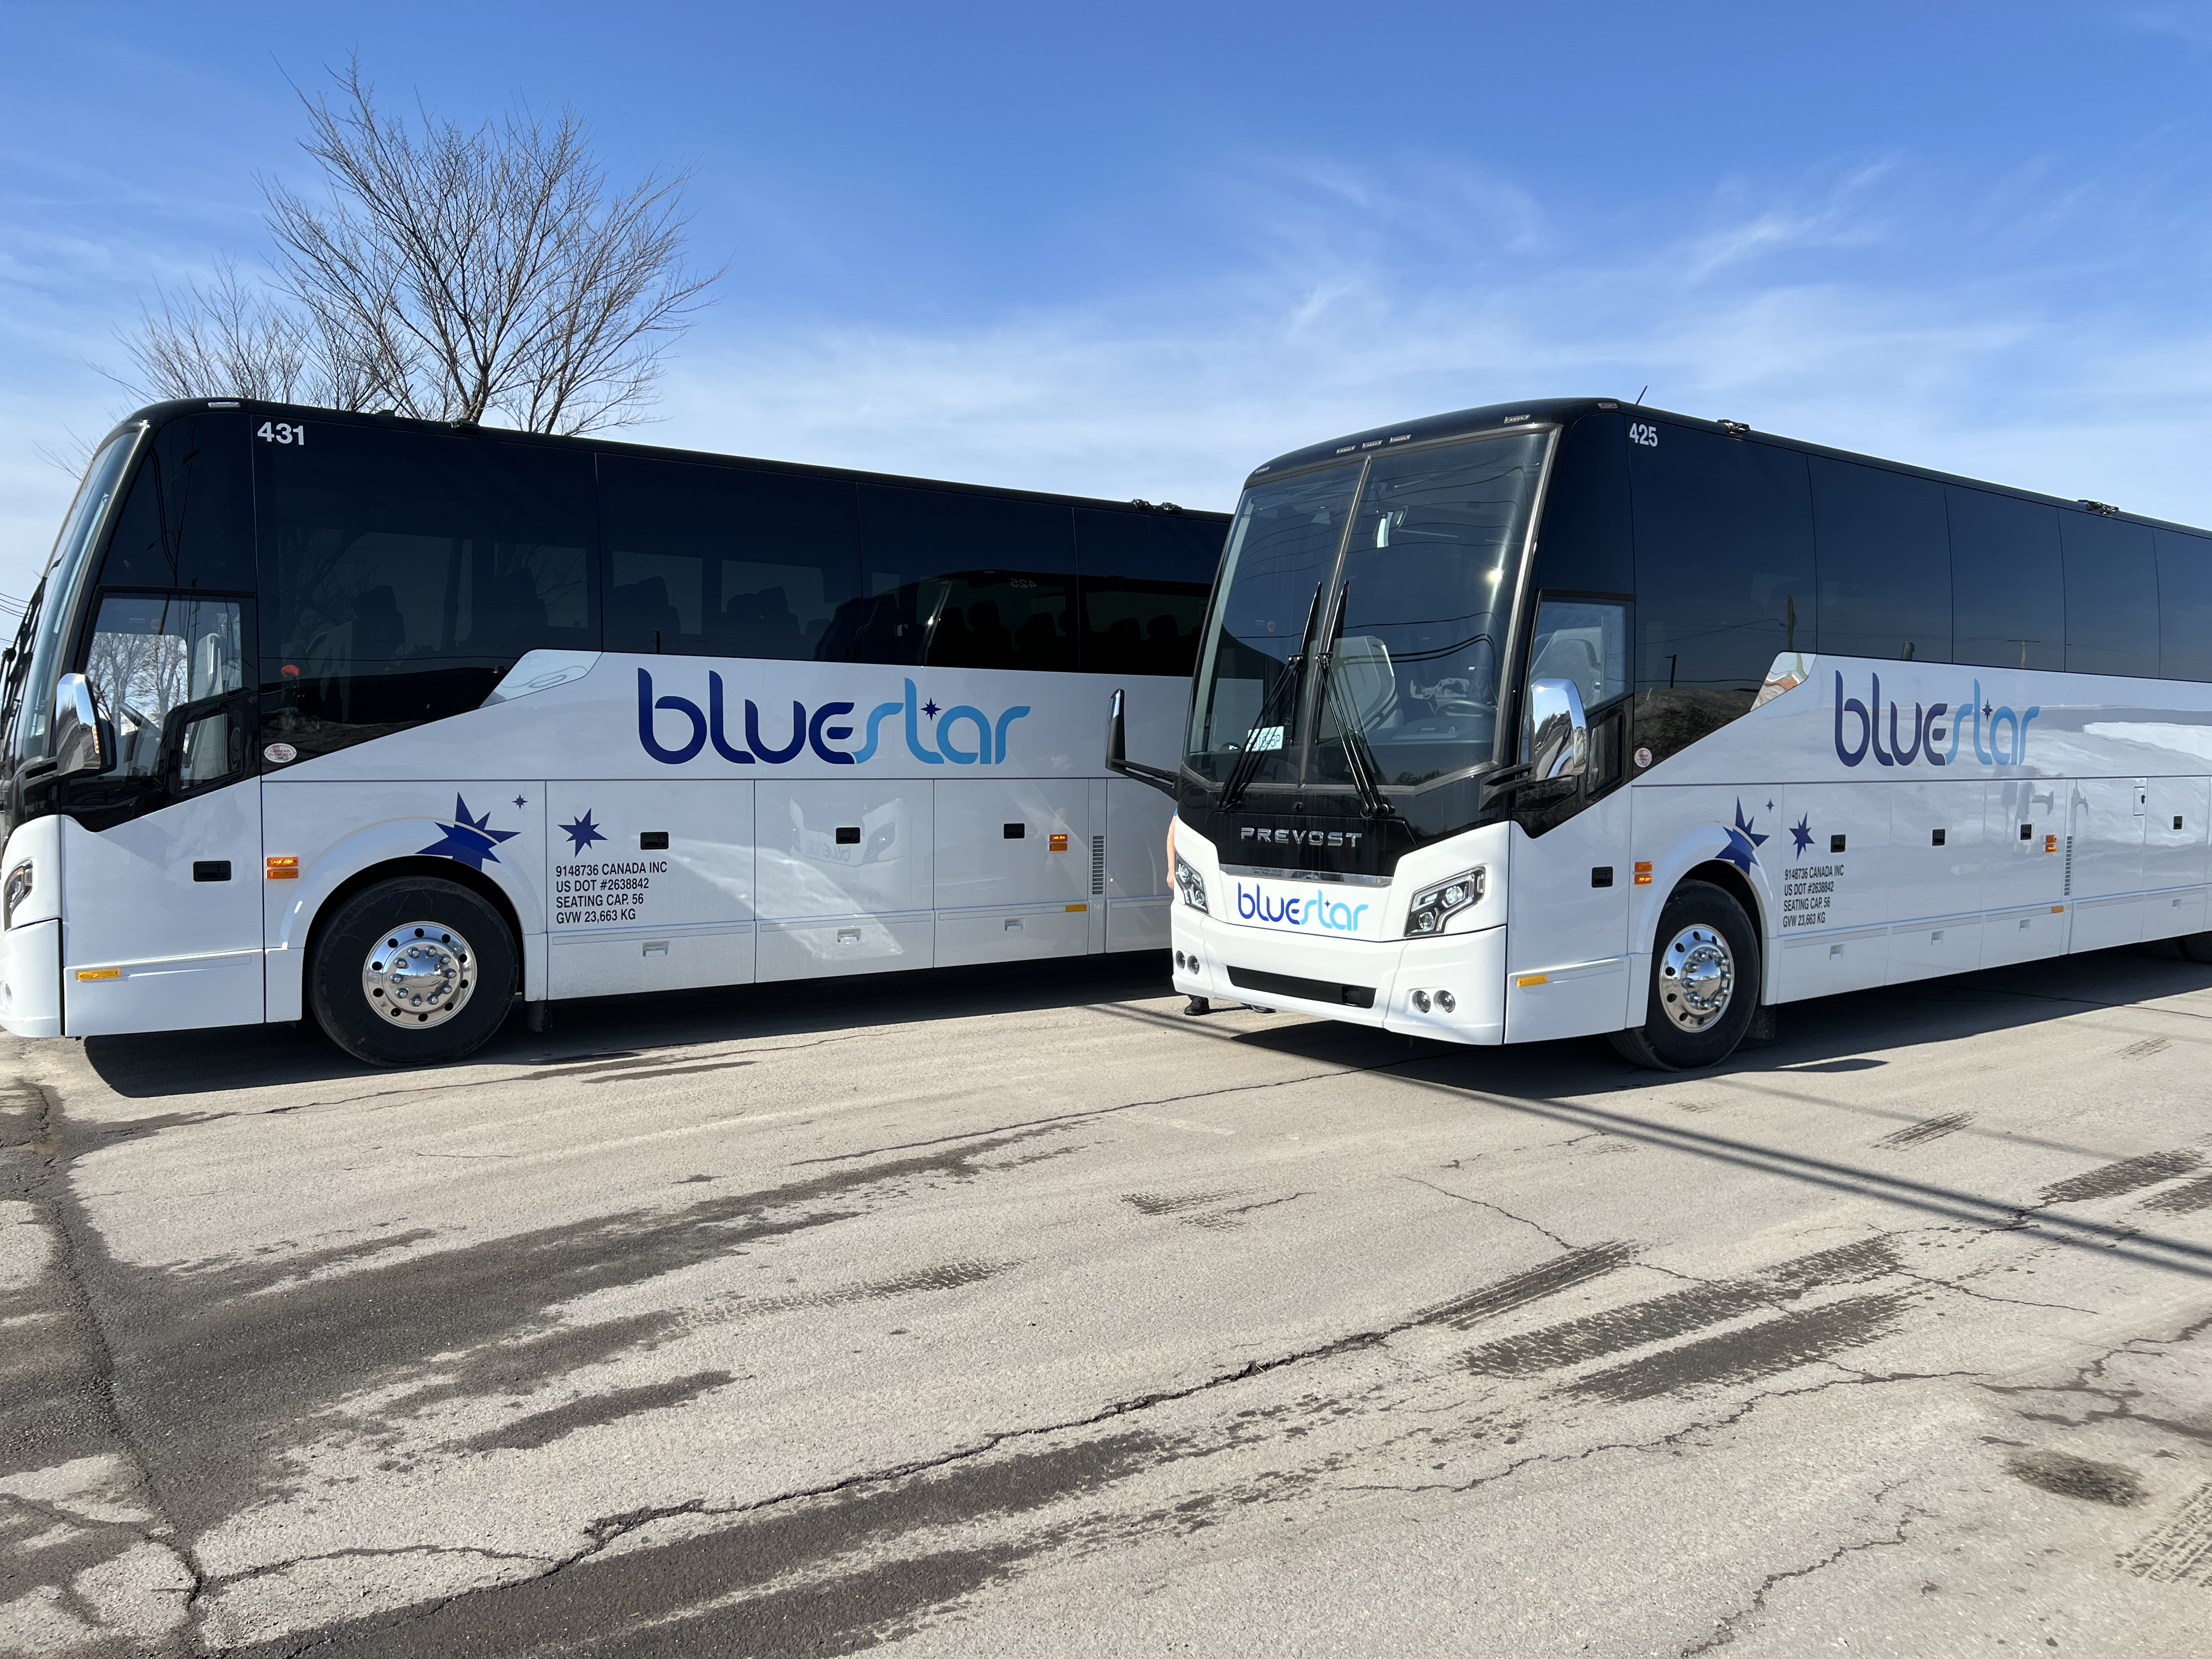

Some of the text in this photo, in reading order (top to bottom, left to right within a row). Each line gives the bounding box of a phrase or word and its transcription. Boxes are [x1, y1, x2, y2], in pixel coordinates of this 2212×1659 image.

[257, 421, 304, 445] 431
[1629, 423, 1658, 447] 425
[637, 667, 1031, 765] bluestar
[1835, 670, 2040, 768] bluestar
[1240, 826, 1362, 848] PREVOST
[556, 861, 668, 877] 9148736 CANADA INC
[1785, 864, 1844, 881] 9148736 CANADA INC
[556, 878, 649, 893] US DOT #2638842
[1784, 881, 1834, 896] US DOT #2638842
[556, 893, 644, 909] SEATING CAP. 56
[1237, 882, 1369, 932] bluestar
[1784, 896, 1831, 912] SEATING CAP. 56
[556, 908, 636, 924] GVW 23,663 KG
[1783, 912, 1826, 928] GVW 23,663 KG
